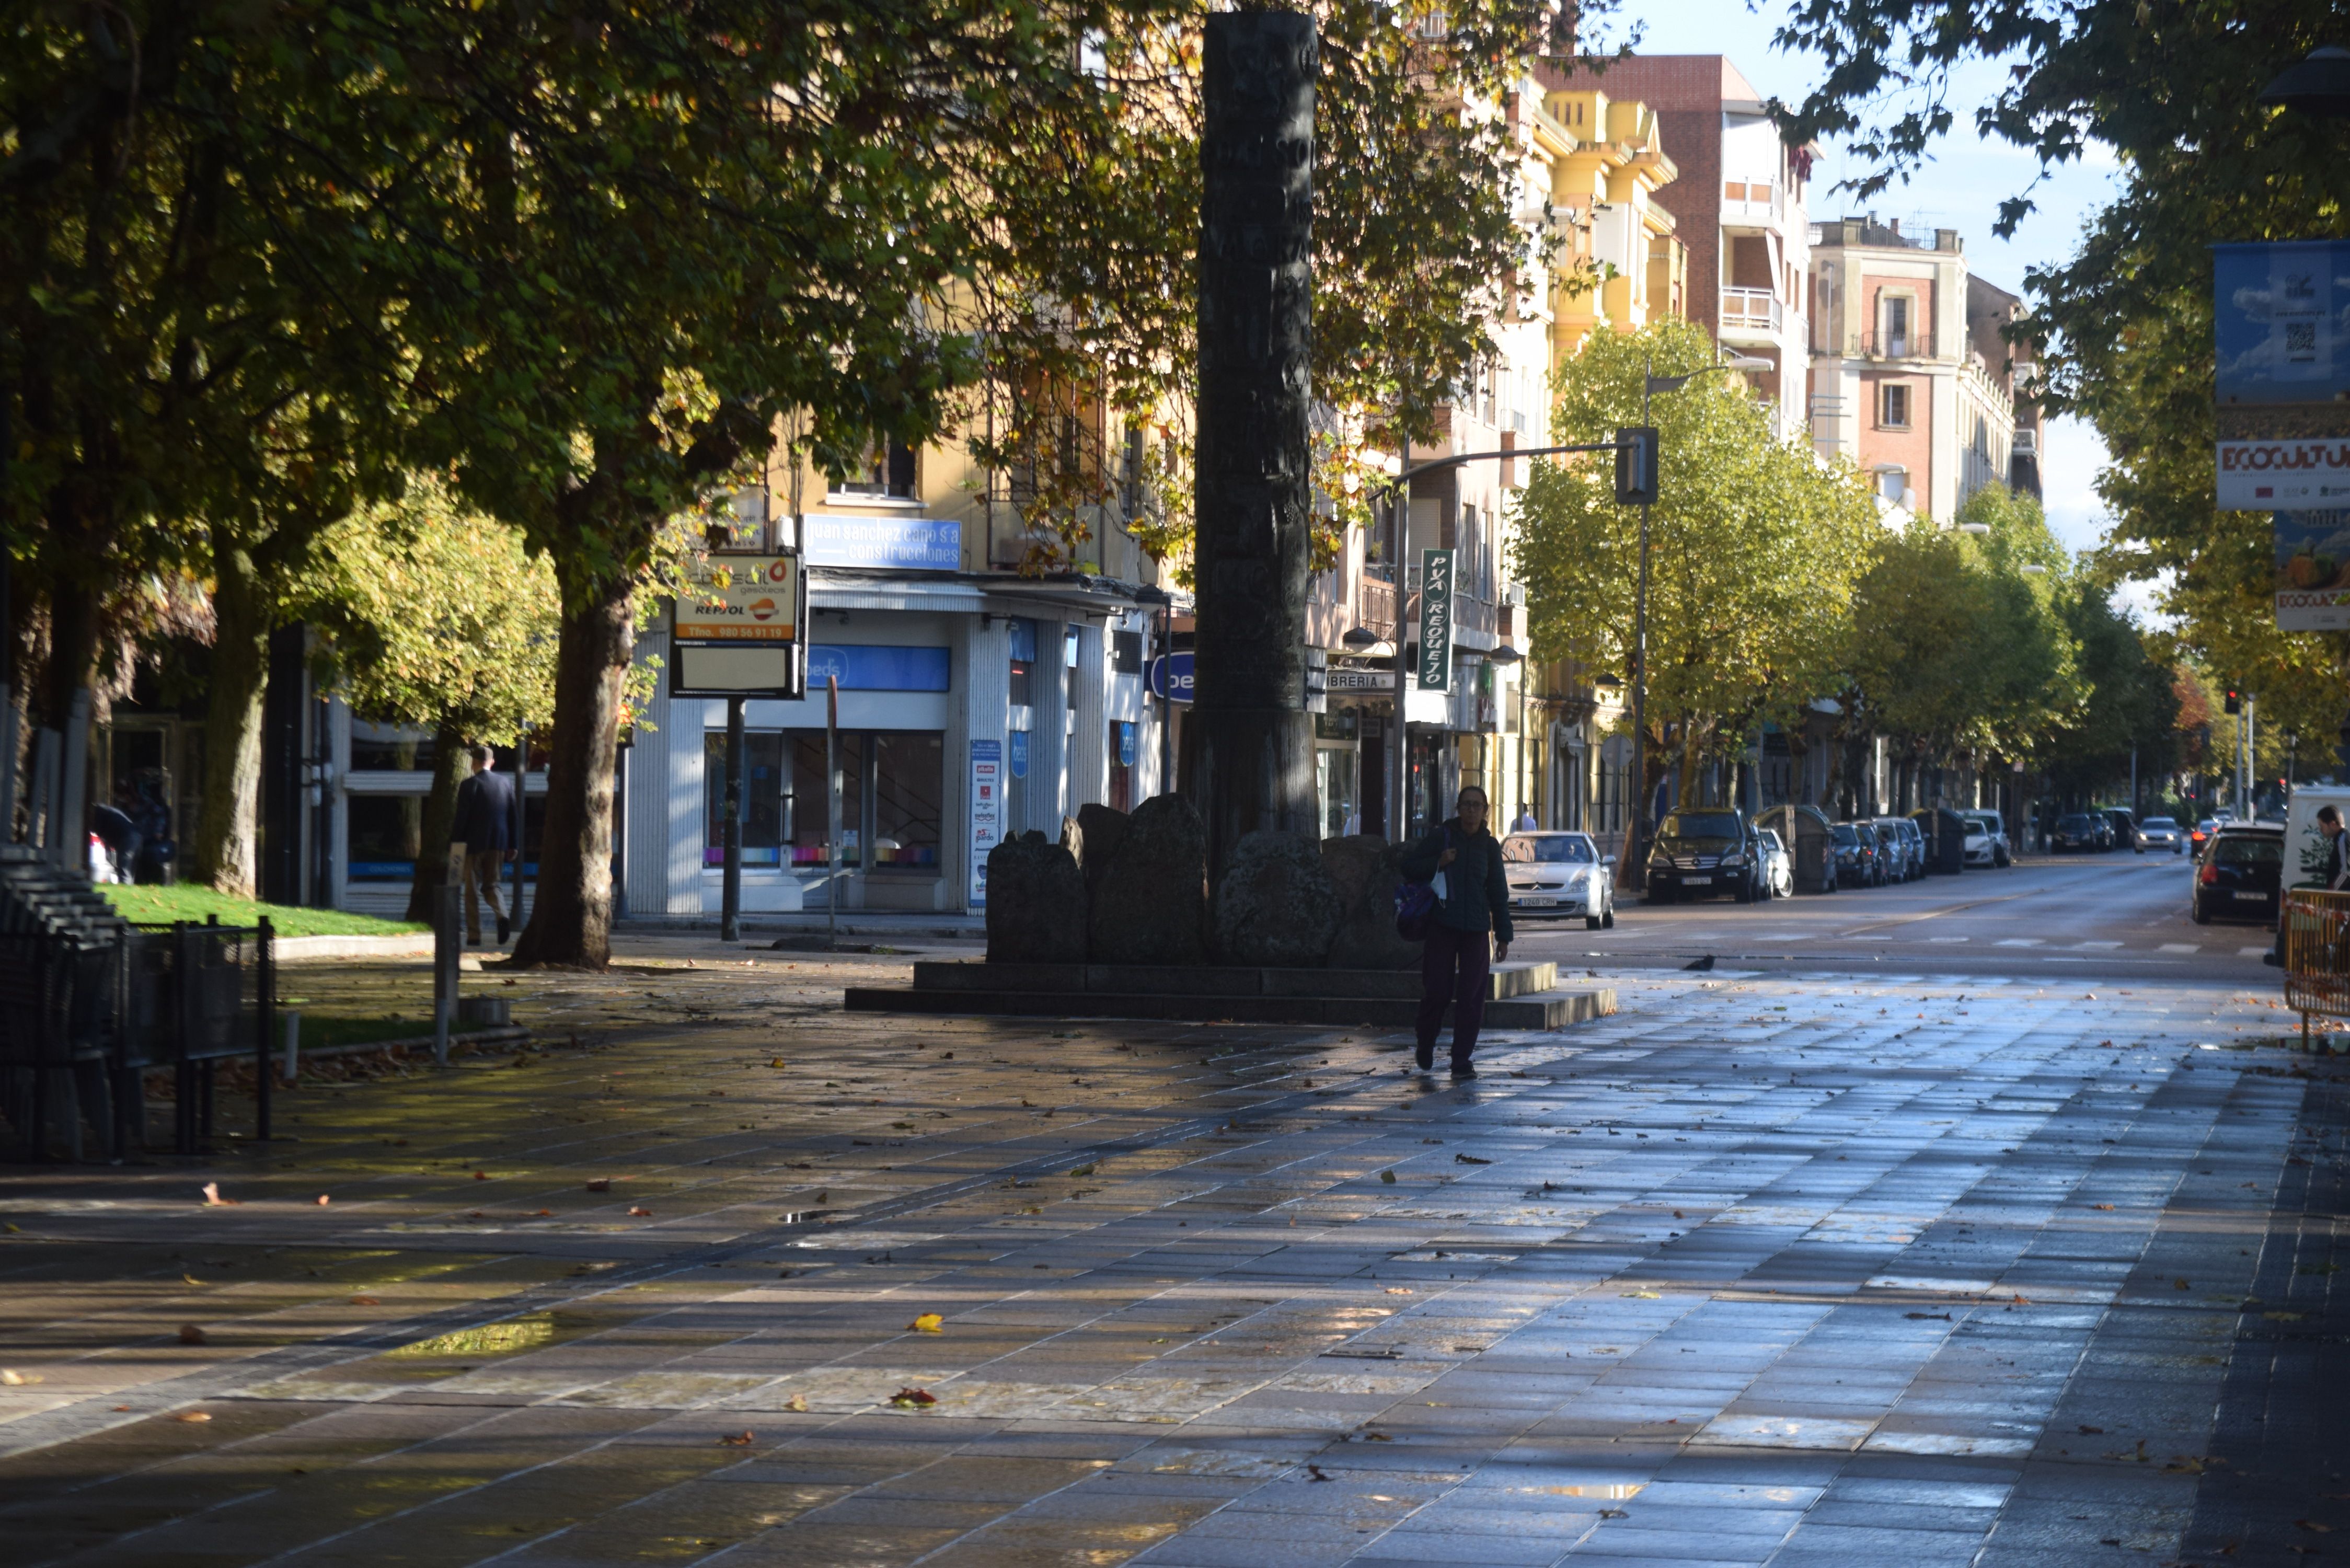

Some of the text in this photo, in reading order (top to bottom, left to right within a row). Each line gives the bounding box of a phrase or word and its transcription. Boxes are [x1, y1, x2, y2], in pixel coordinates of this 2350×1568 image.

[2222, 445, 2350, 470] ECOCULTU
[805, 523, 840, 547] juan
[842, 518, 901, 542] sanchez
[903, 529, 936, 544] cano
[950, 529, 959, 544] a
[848, 544, 959, 563] construcciones
[720, 628, 738, 637] 980
[741, 628, 753, 637] 56
[755, 628, 766, 637] 91
[770, 628, 782, 638] 19
[1327, 676, 1377, 687] IBRERIA
